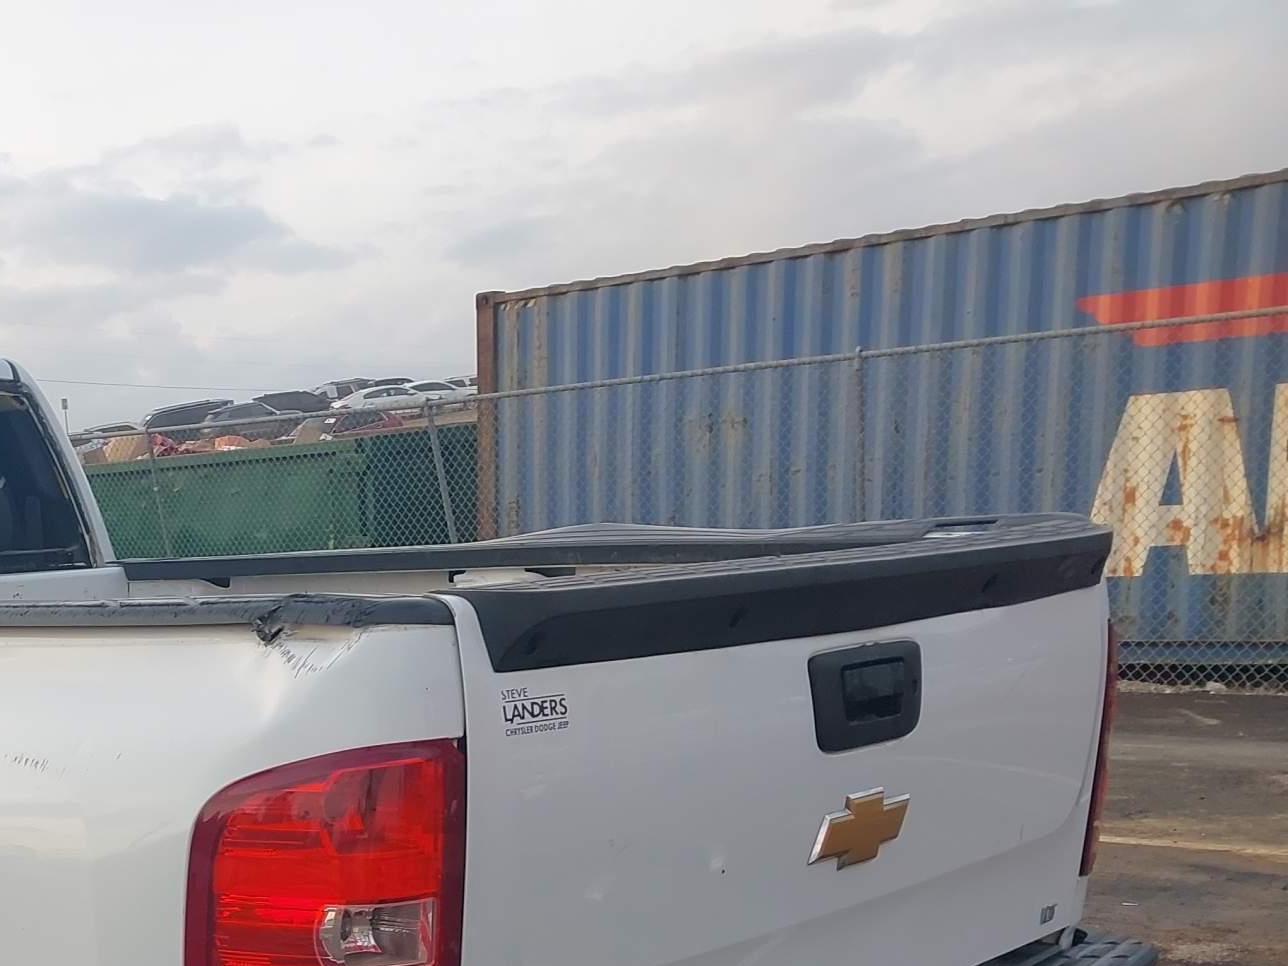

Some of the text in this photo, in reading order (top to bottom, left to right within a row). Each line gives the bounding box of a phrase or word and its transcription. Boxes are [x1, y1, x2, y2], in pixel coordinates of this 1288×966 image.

[1090, 380, 1288, 578] A
[501, 687, 528, 700] STEVE
[503, 697, 568, 724] LANDERS
